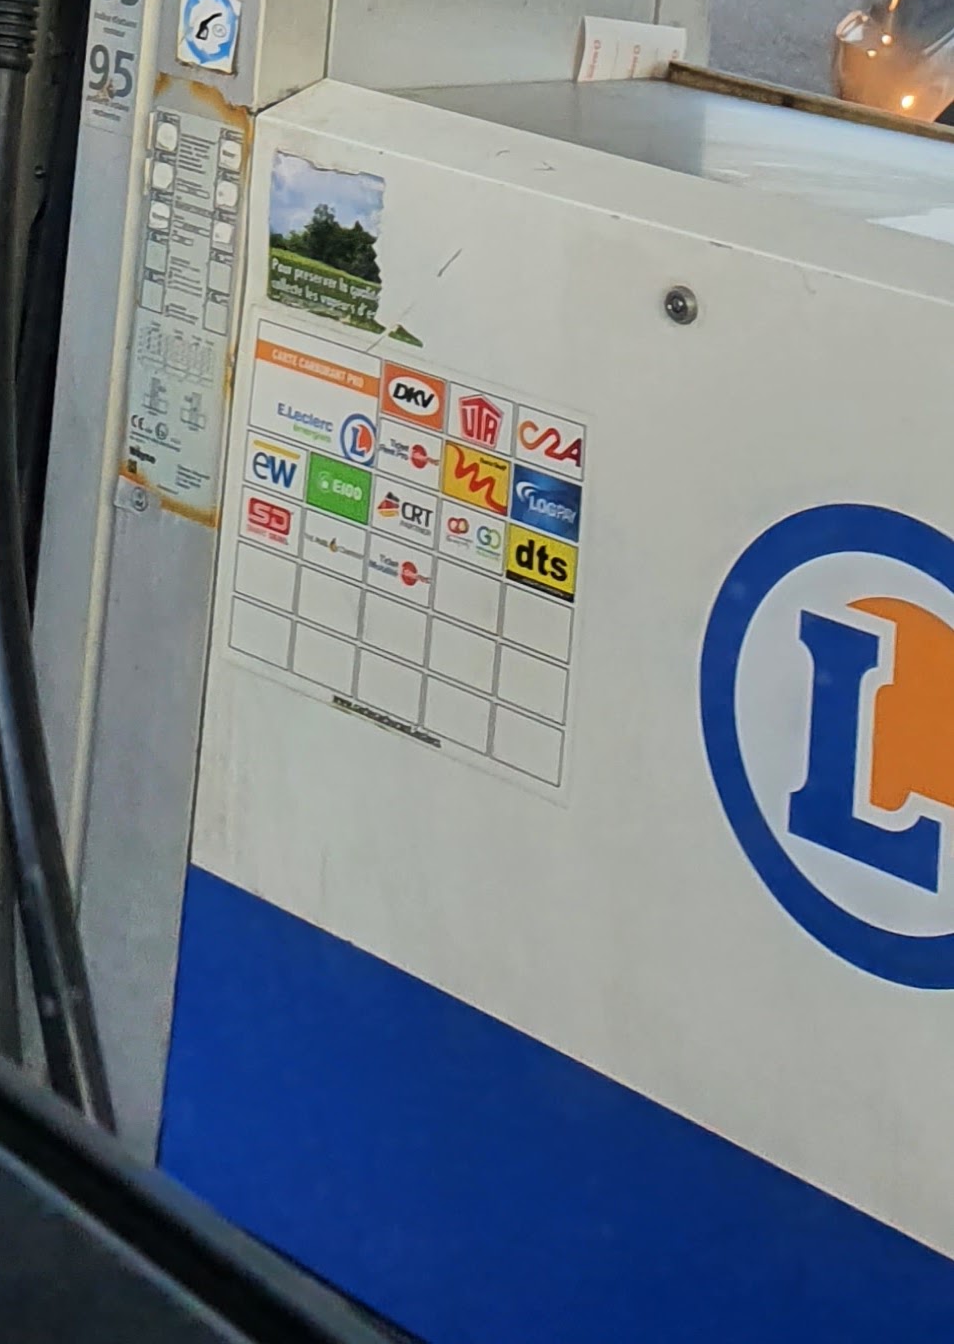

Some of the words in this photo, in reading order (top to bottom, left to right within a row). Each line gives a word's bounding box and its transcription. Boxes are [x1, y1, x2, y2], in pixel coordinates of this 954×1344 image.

[89, 44, 134, 98] 95
[392, 382, 435, 410] DKV
[277, 402, 334, 433] E.Leclerc
[461, 402, 501, 446] UTA
[401, 501, 434, 528] CRT
[515, 539, 568, 582] dts
